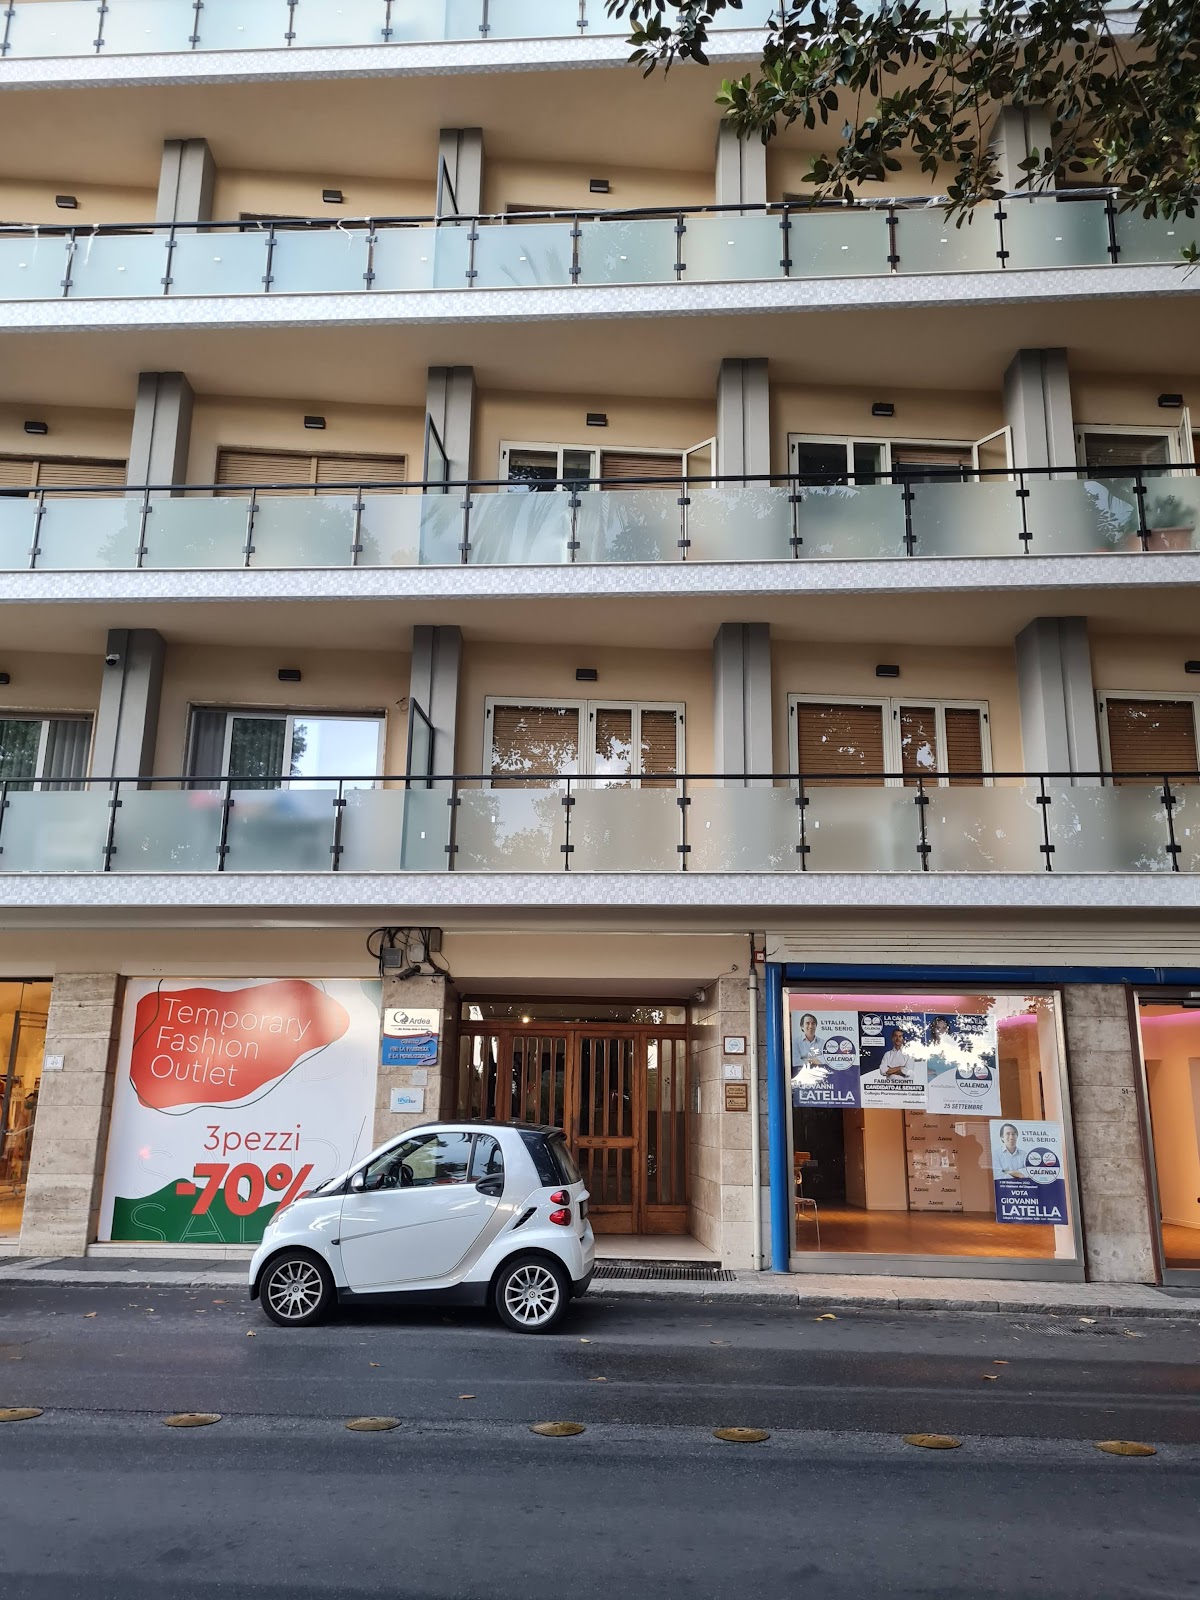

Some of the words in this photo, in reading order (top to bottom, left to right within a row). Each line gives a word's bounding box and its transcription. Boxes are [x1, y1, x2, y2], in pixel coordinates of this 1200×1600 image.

[163, 997, 312, 1042] Temporary
[408, 1017, 431, 1025] Ardea
[156, 1026, 259, 1060] Fashion
[150, 1054, 238, 1087] Outlet
[799, 1090, 855, 1101] LATELLA
[203, 1123, 301, 1157] 3pezzi
[176, 1162, 315, 1217] -70%
[1001, 1197, 1039, 1205] GIOVANNI
[1002, 1205, 1062, 1217] LATELLA
